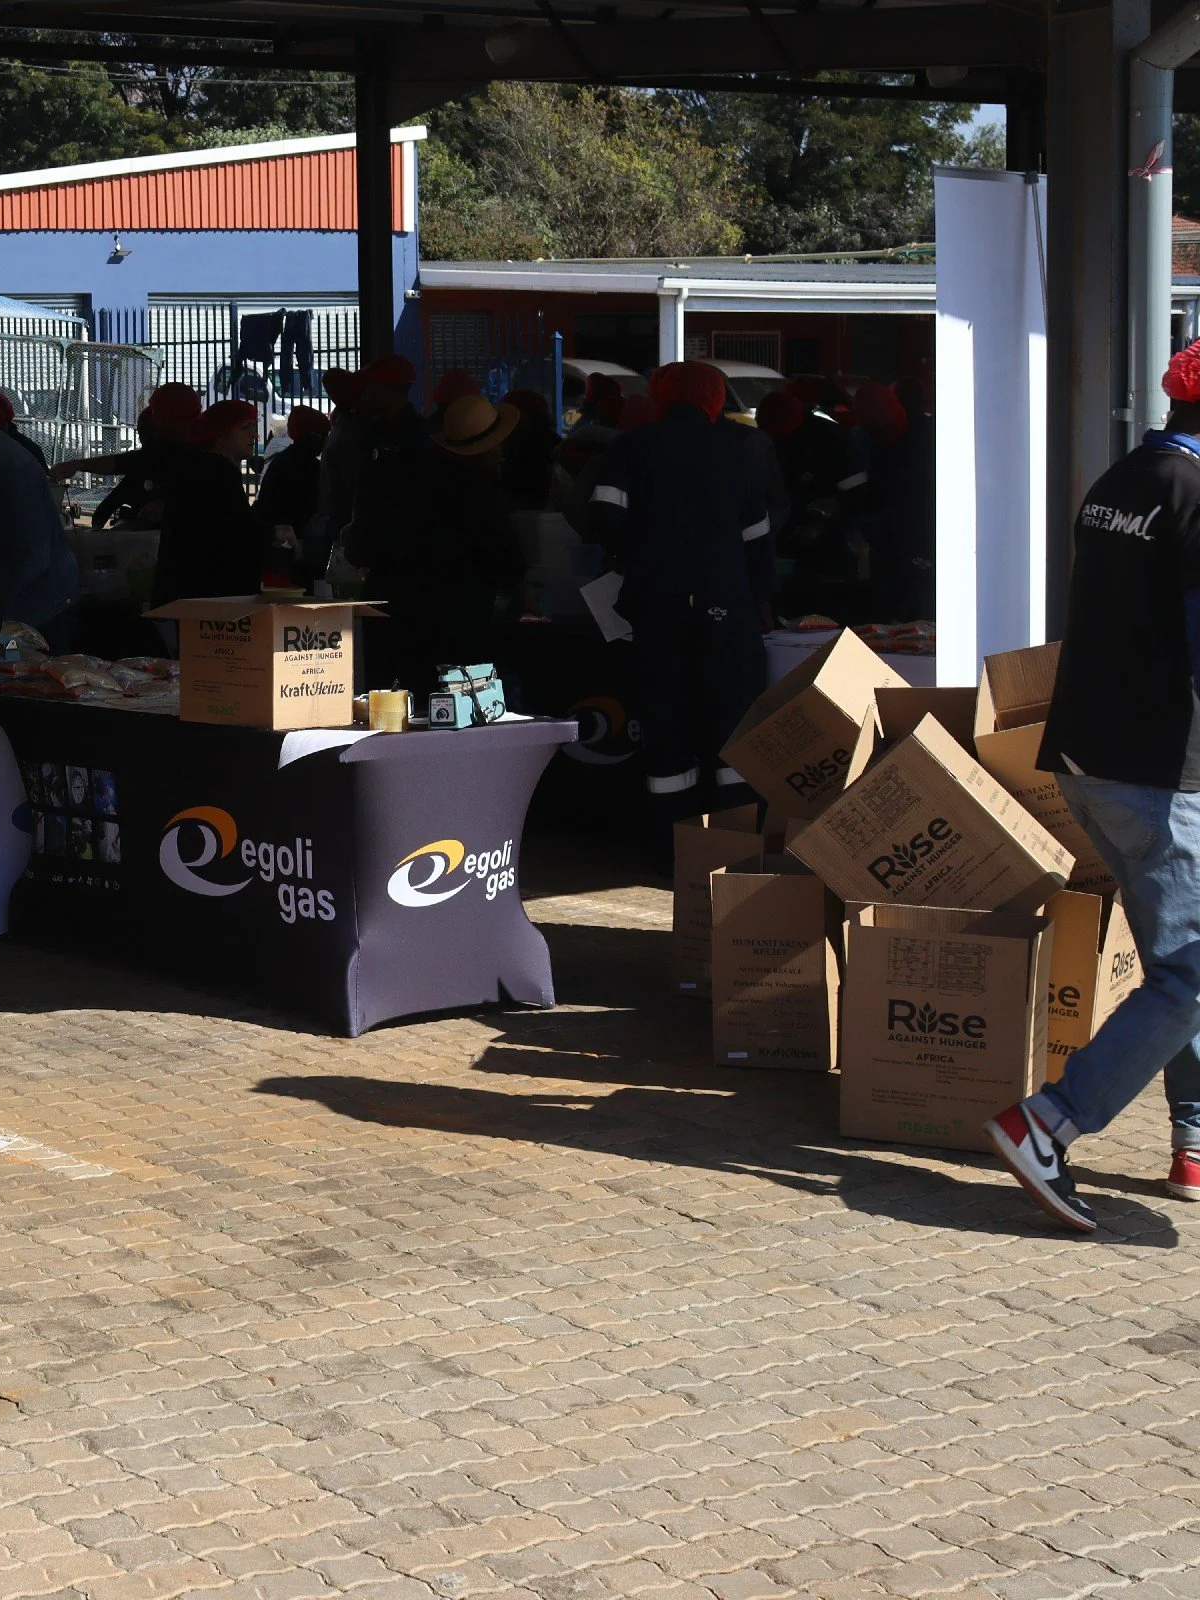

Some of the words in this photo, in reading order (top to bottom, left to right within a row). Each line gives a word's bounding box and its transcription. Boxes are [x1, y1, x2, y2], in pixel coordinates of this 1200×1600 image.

[284, 625, 342, 652] Rise
[284, 653, 313, 662] AGAINST
[316, 652, 343, 660] HUNGER
[1037, 790, 1062, 801] RELI
[240, 837, 314, 882] egoli
[464, 838, 514, 878] egoli
[867, 818, 953, 890] Rise
[892, 864, 928, 898] AGAINST
[927, 832, 963, 866] HUNGER
[486, 866, 516, 901] gas
[924, 865, 954, 892] AFRICA
[278, 883, 336, 924] gas
[732, 938, 809, 948] HUMANITARIAN
[754, 948, 786, 956] RELIEF
[1048, 983, 1080, 1008] se
[888, 998, 986, 1038] Rise
[888, 1034, 936, 1045] AGAINST
[940, 1038, 987, 1050] HUNGER
[916, 1053, 955, 1064] AFRICA
[898, 1120, 950, 1136] mpact
